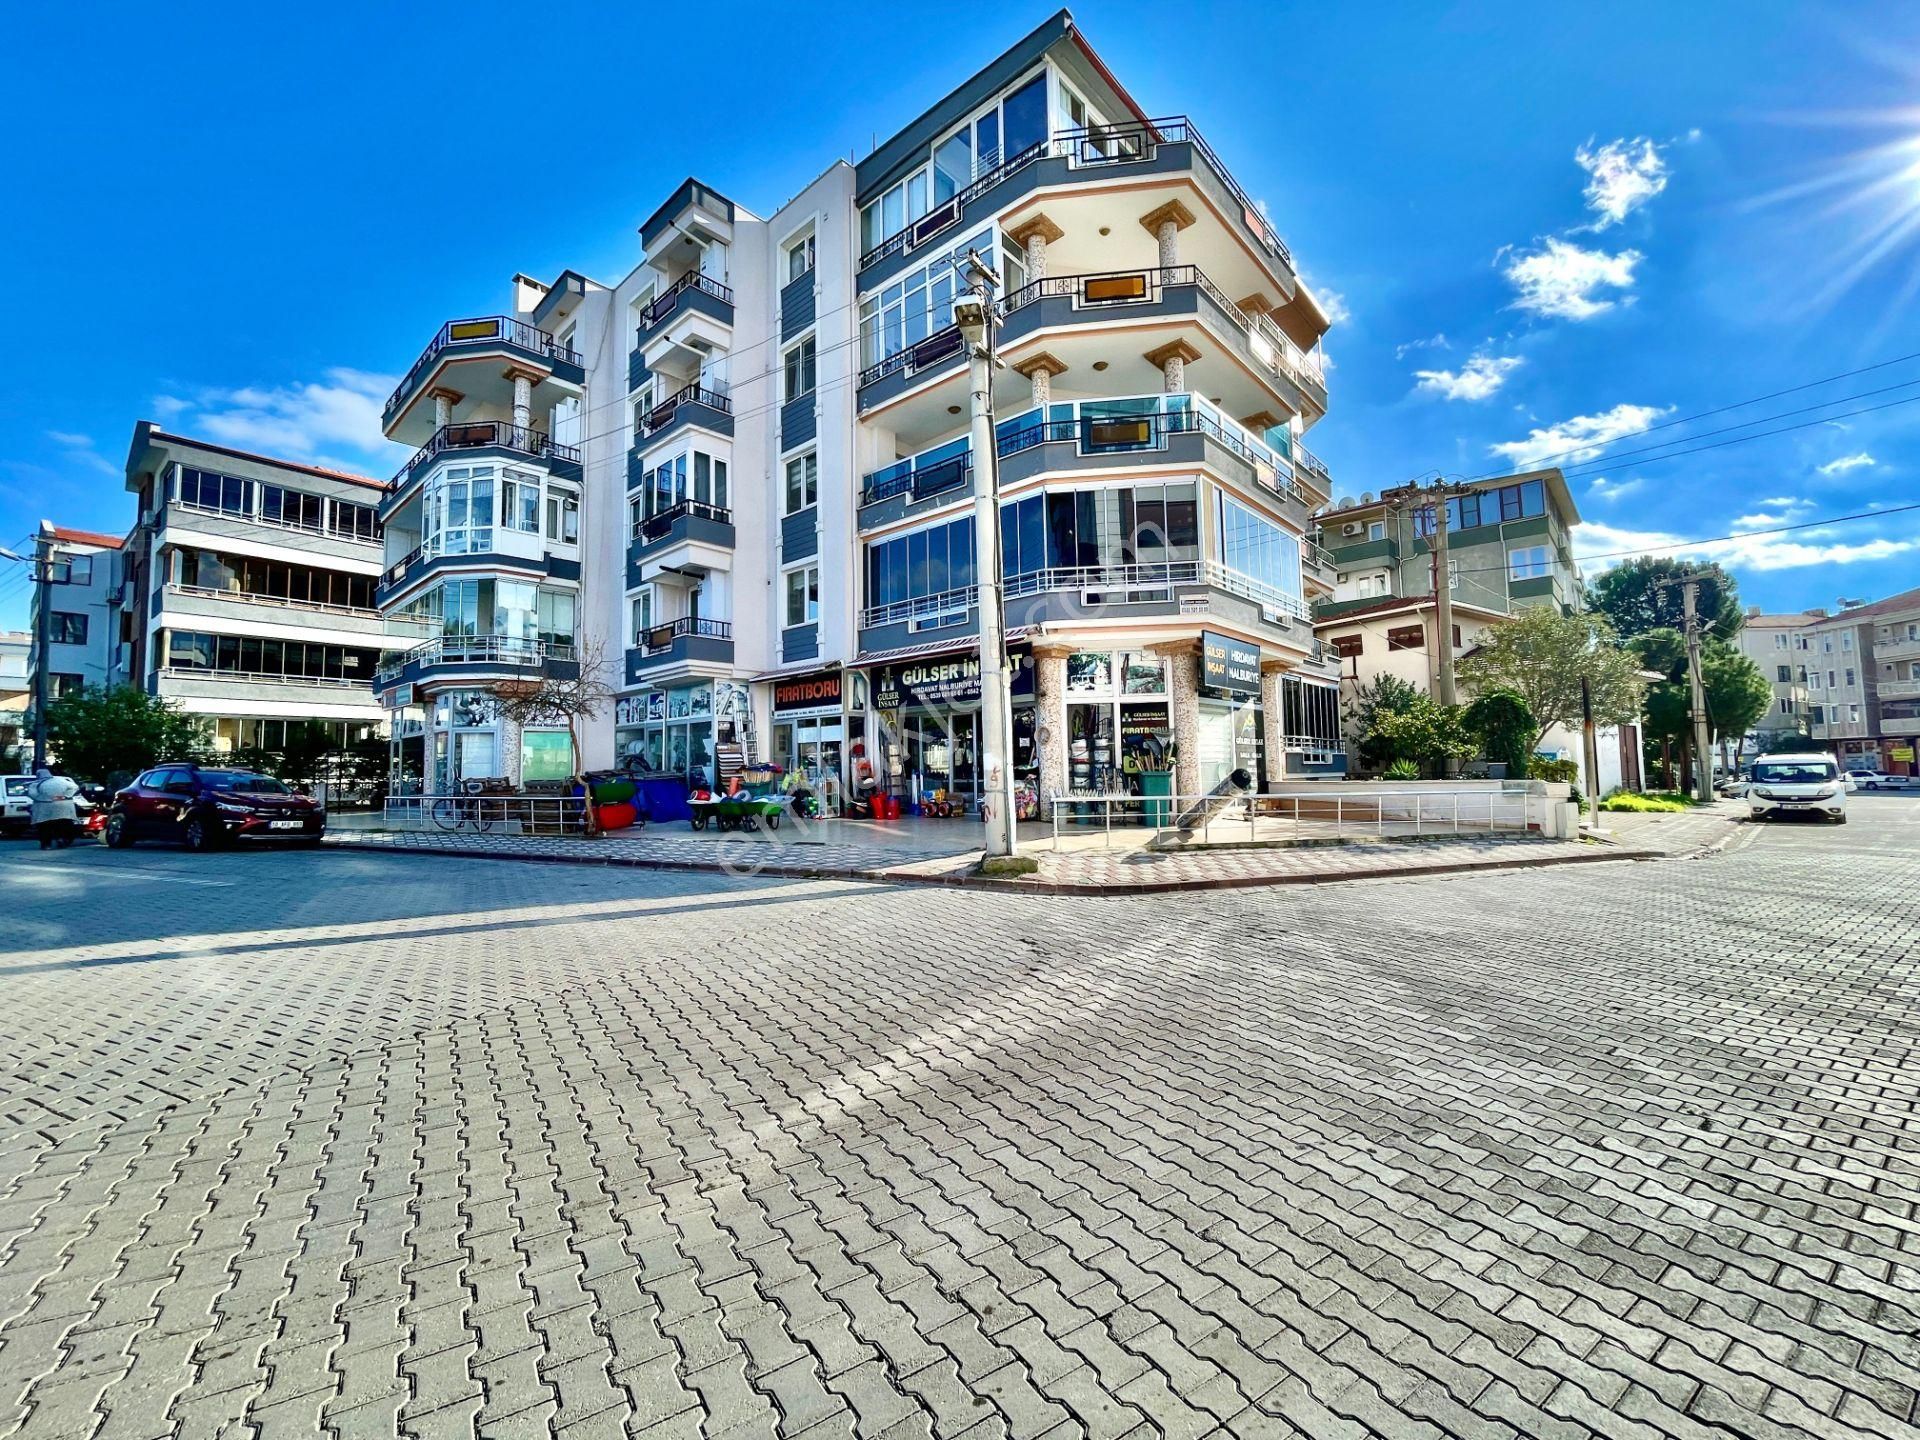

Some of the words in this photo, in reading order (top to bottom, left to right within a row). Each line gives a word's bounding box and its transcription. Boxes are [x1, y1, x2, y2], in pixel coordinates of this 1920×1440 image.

[902, 663, 959, 686] GÜLSER
[963, 653, 1023, 678] İNAT
[776, 679, 841, 703] FIRATBORU
